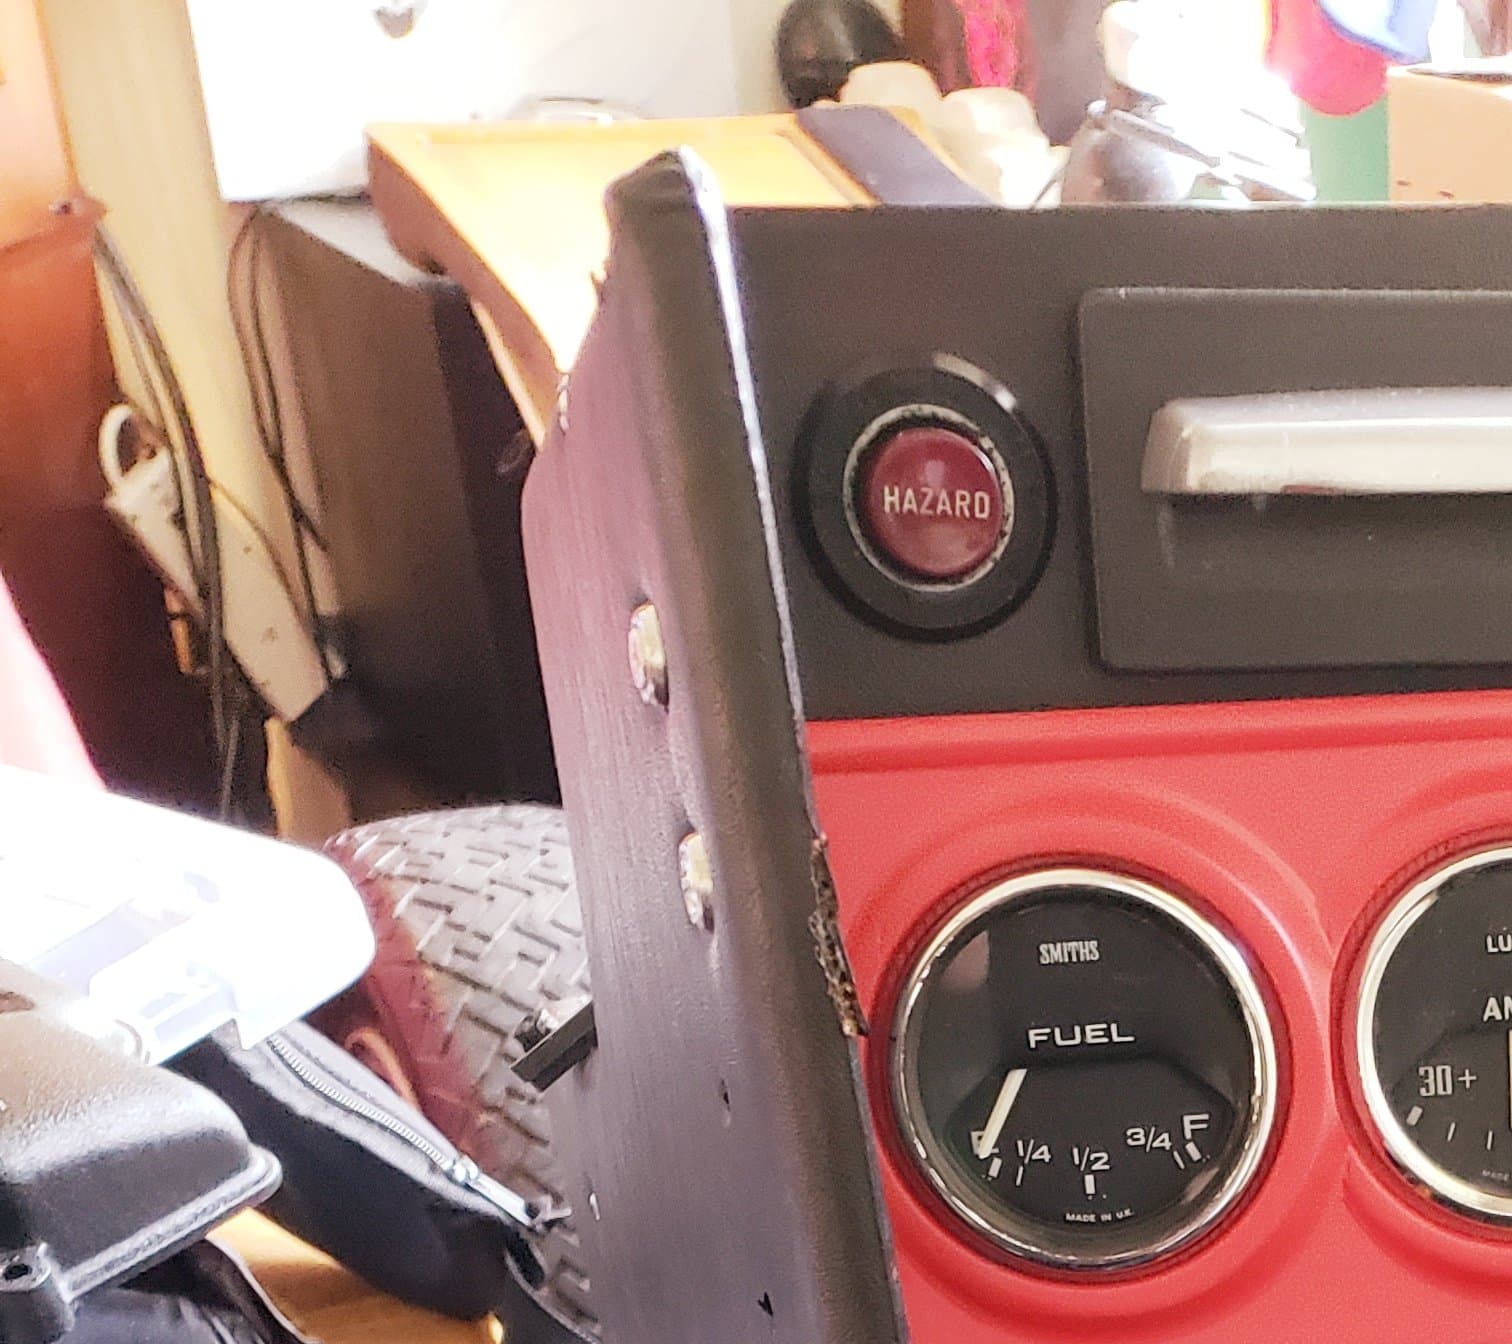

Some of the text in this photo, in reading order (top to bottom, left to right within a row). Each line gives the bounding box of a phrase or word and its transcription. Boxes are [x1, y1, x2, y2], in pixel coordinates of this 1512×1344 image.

[883, 485, 990, 520] HAZARD
[1039, 939, 1100, 965] SMITHS
[1027, 1022, 1136, 1048] FUEL
[1017, 1138, 1052, 1164] 1/4
[1071, 1146, 1111, 1172] 1/2
[1126, 1125, 1172, 1153] 3/4
[1182, 1112, 1210, 1140] F
[1065, 1211, 1097, 1223] MADE
[1100, 1212, 1112, 1223] IN
